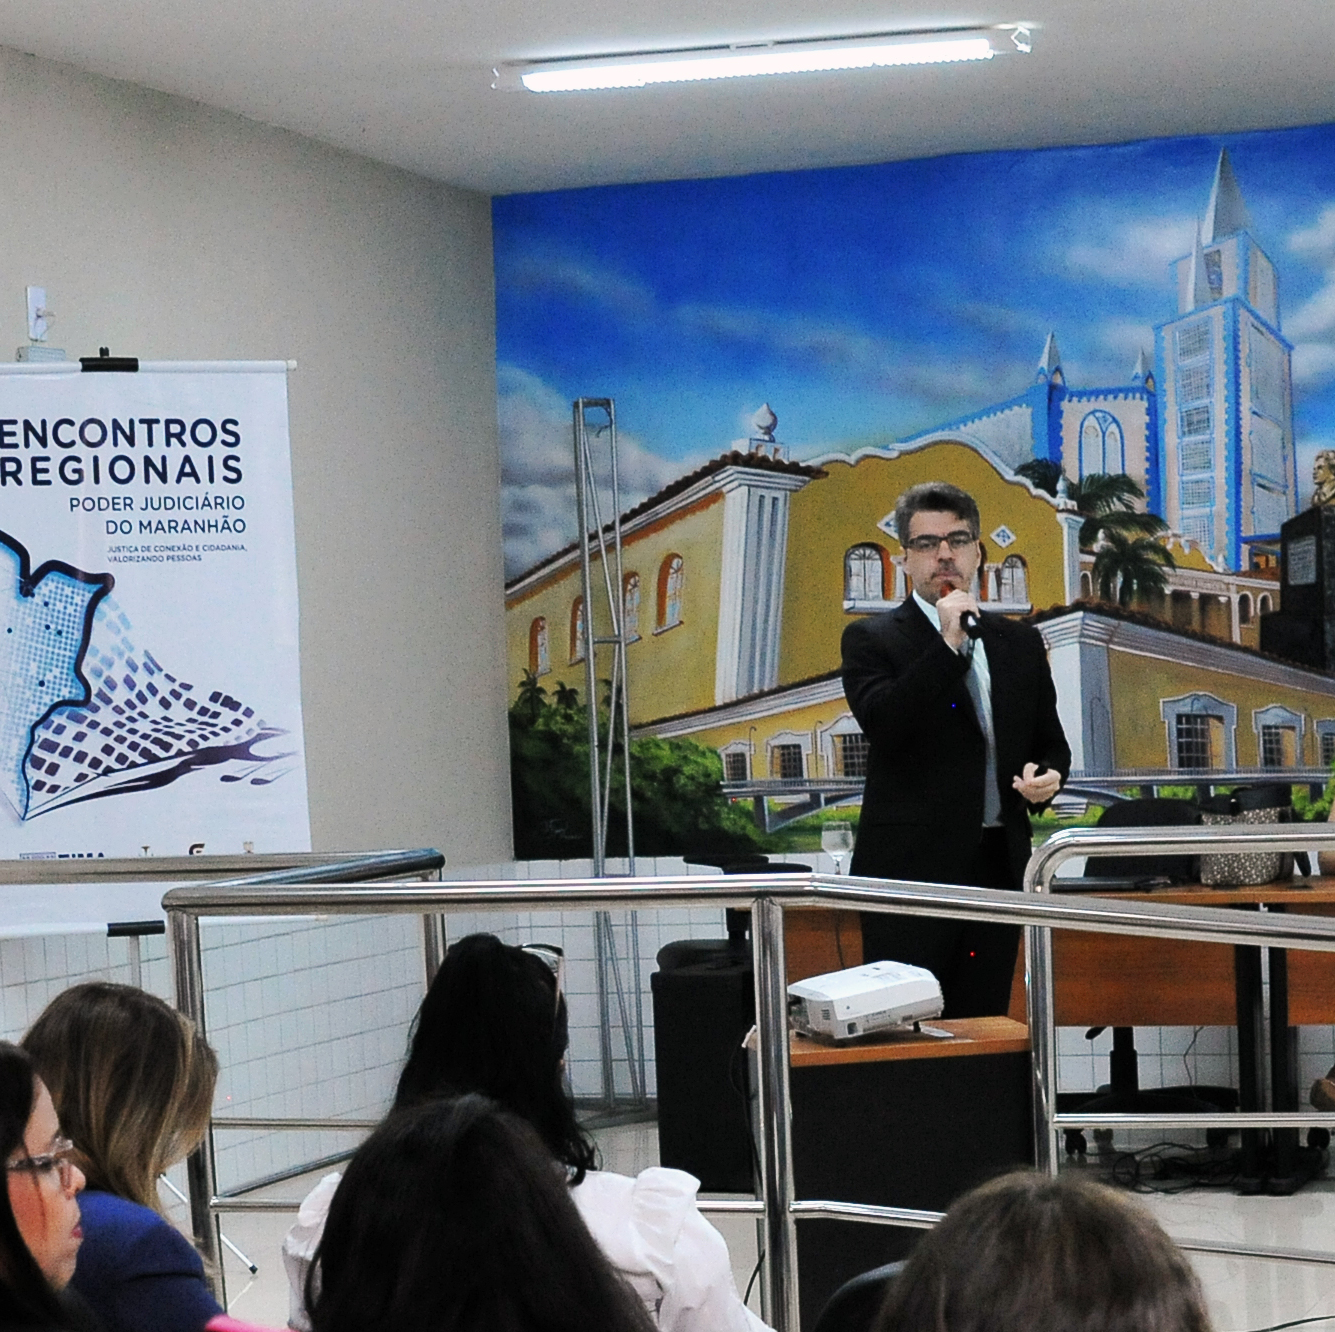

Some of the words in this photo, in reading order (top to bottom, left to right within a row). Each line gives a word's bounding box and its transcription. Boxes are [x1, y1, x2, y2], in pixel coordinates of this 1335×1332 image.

[0, 454, 243, 487] REGIONAIS
[69, 497, 134, 512] PODER
[140, 492, 245, 511] JUDICIÁRIO
[106, 519, 132, 535] DO
[139, 515, 246, 534] MARANHÃO
[107, 545, 139, 553] JUSTIÇA
[154, 544, 193, 552] CONEXÃO
[202, 544, 247, 552] CIDADANIA,
